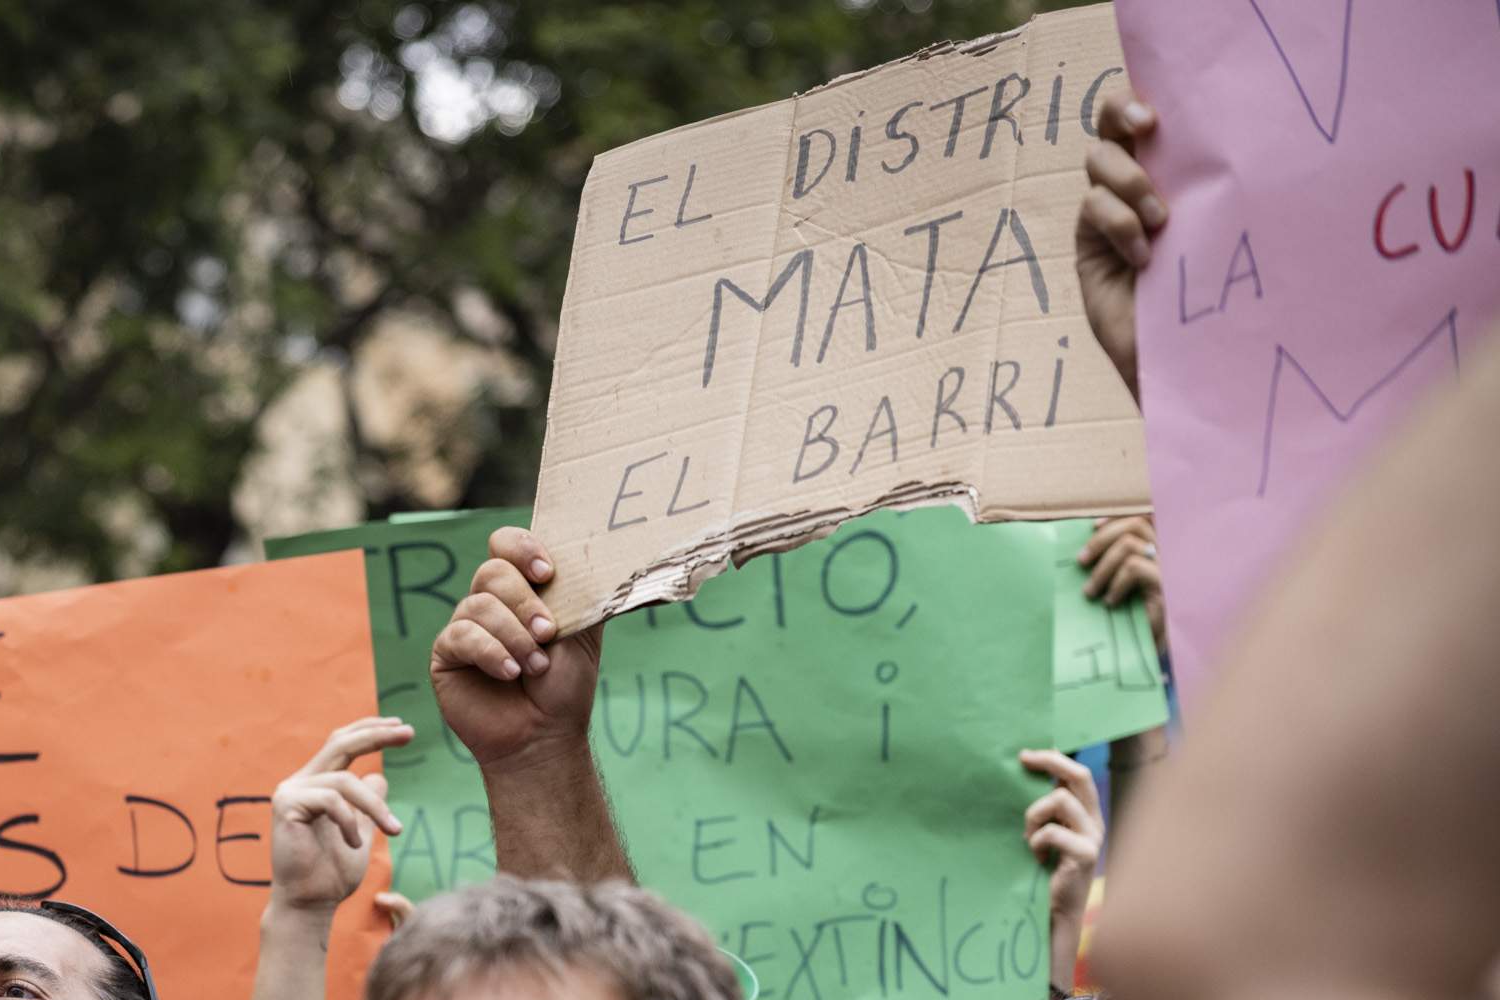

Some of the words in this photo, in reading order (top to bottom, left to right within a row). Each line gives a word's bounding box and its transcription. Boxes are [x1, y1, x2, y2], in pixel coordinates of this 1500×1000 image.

[618, 163, 712, 246] EL
[1179, 230, 1263, 325] LA
[1373, 166, 1500, 261] CU
[702, 206, 1050, 389] MATA
[607, 451, 711, 532] EL
[691, 805, 822, 885] EN
